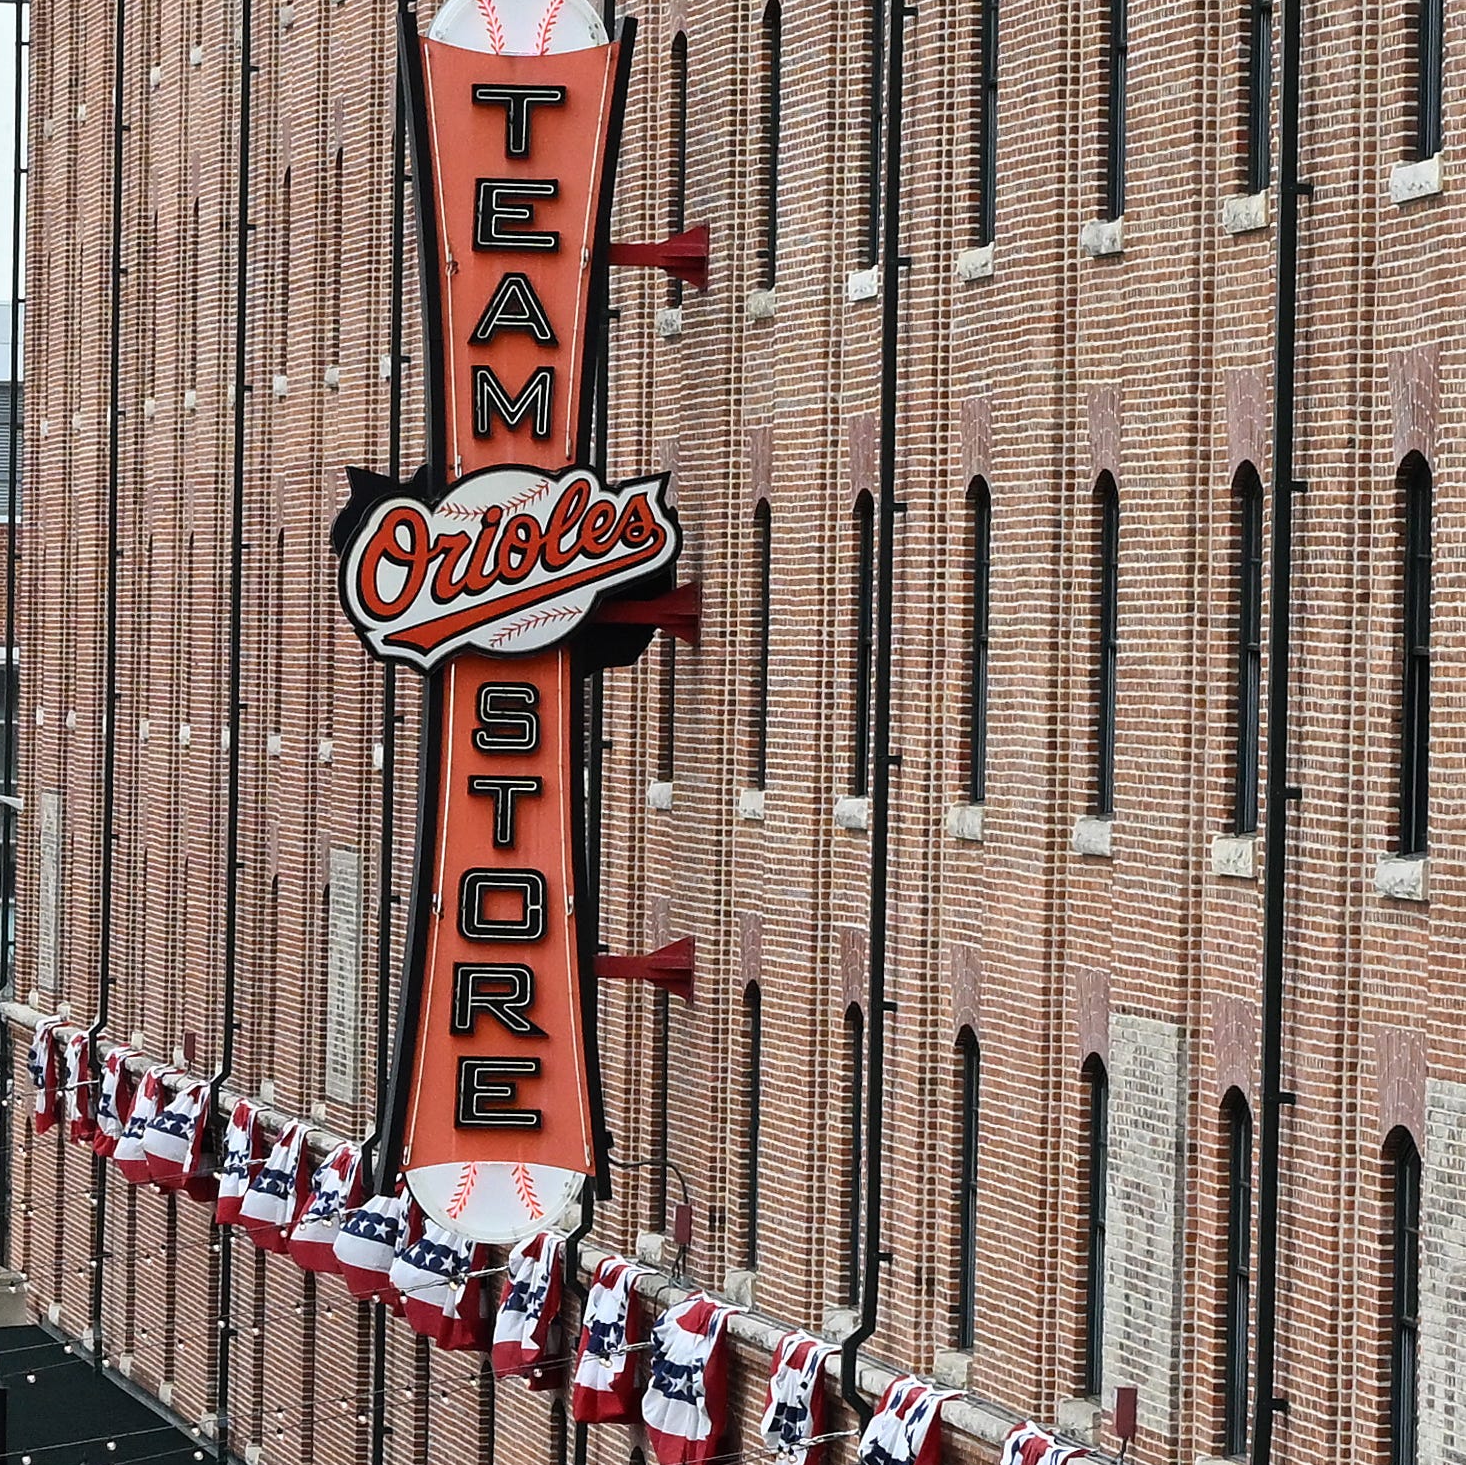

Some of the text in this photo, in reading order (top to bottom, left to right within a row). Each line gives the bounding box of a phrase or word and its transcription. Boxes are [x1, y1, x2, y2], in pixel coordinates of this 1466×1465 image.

[472, 84, 566, 440] TEAM
[356, 478, 664, 622] Orioles
[450, 683, 550, 1132] STORE
